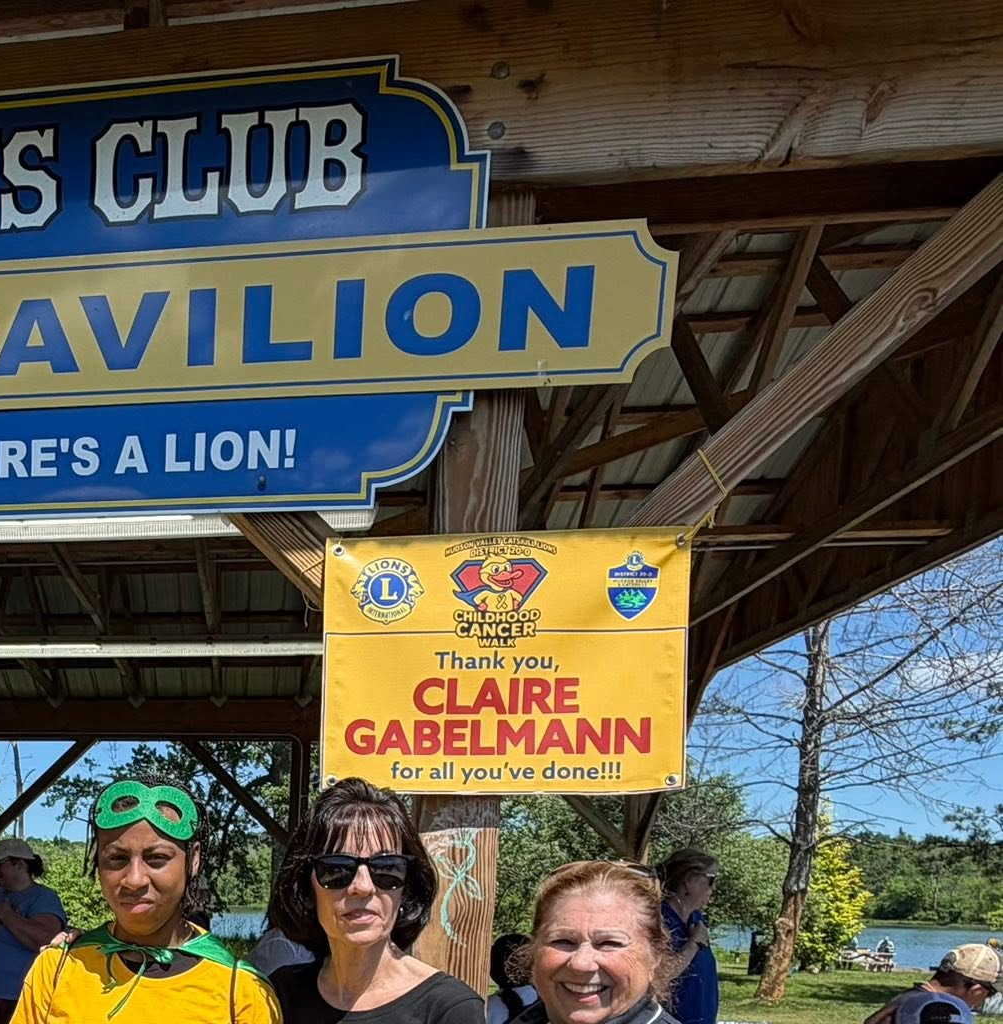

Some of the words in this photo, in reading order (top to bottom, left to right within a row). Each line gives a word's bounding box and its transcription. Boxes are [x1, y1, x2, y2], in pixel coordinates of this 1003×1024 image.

[93, 102, 365, 226] CLUB
[115, 434, 148, 475] A
[164, 428, 297, 473] LION!
[445, 541, 474, 557] HUDSON
[476, 537, 502, 547] VALLEY
[537, 541, 557, 555] LIONS
[470, 546, 509, 558] DISTRICT
[368, 560, 409, 574] LIONS
[380, 577, 399, 600] L
[453, 609, 541, 623] CHILDHOOD
[456, 621, 536, 638] CANCER
[478, 637, 516, 648] WALK
[435, 651, 506, 670] Thank
[512, 655, 560, 674] you,
[413, 677, 580, 715] CLAIRE
[344, 717, 652, 756] GABELMANN
[391, 762, 424, 780] for
[429, 761, 454, 780] all
[462, 762, 537, 784] you've
[542, 761, 622, 780] done!!!
